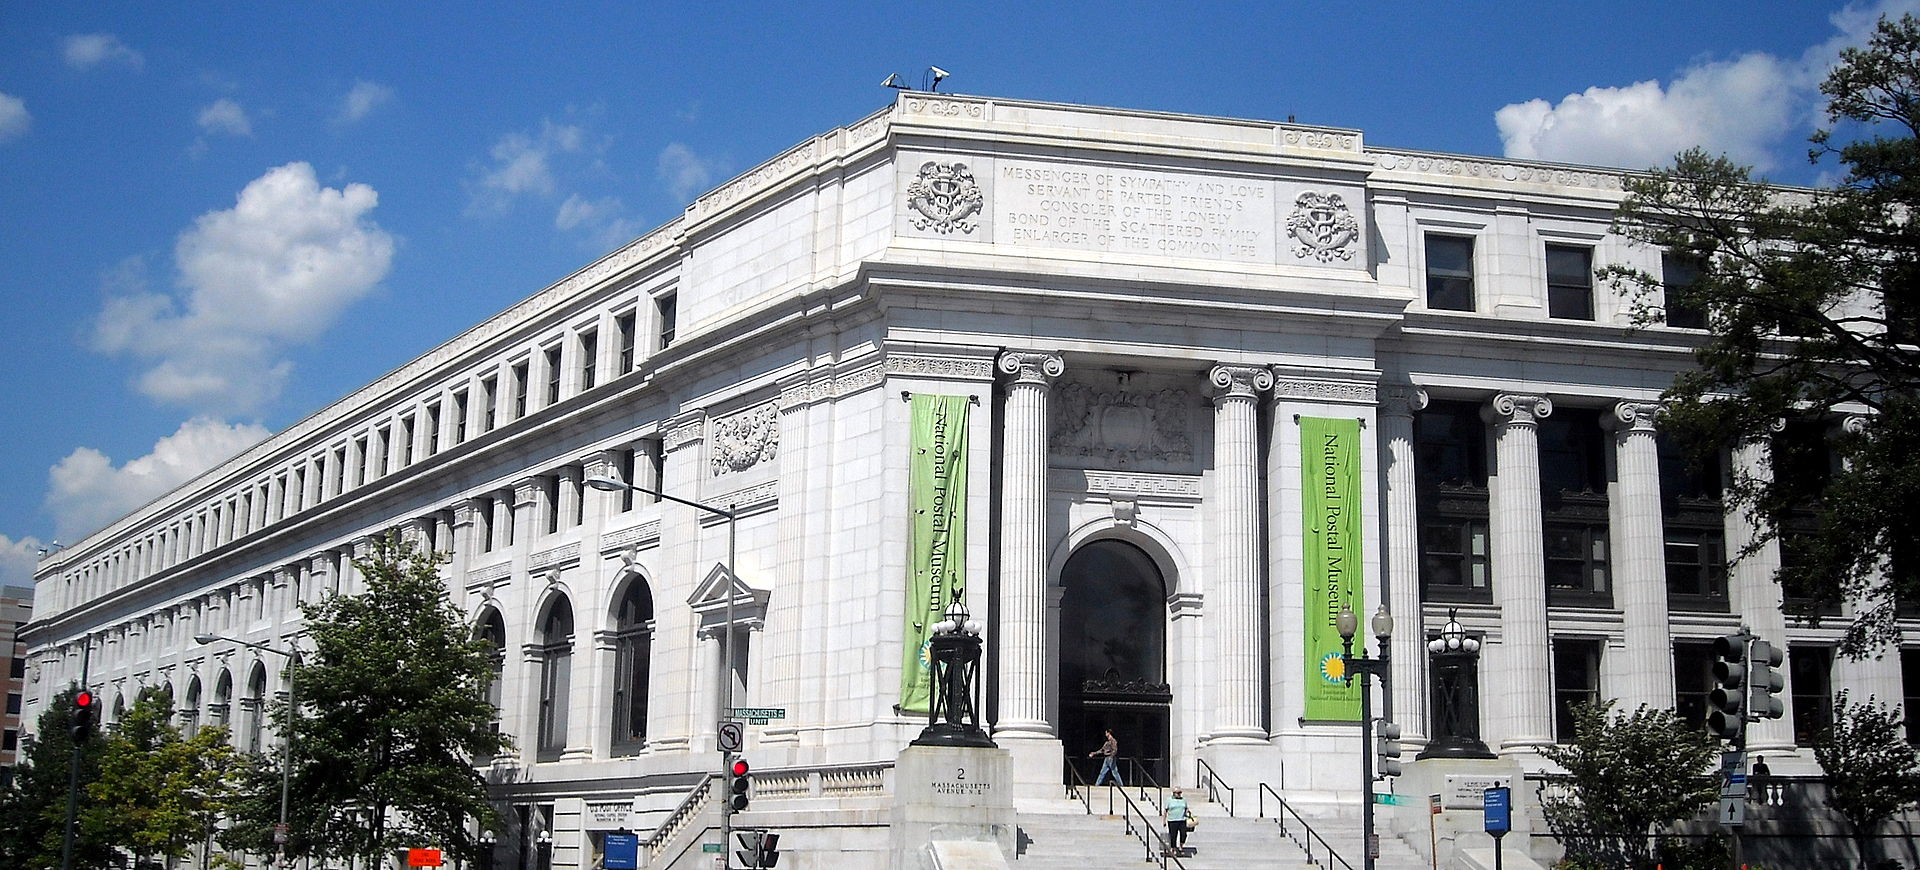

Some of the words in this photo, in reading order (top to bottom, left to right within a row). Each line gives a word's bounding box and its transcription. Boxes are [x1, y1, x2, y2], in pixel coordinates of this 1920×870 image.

[1003, 167, 1090, 185] MESSENGER
[1096, 174, 1113, 186] OF
[1120, 176, 1190, 193] SYMPATHY
[1197, 183, 1224, 195] AND
[1230, 185, 1264, 198] LOVE
[1027, 184, 1090, 199] SERVANT
[1096, 189, 1113, 201] OF
[1120, 191, 1172, 206] PARTED
[1181, 196, 1243, 211] FRIENDS
[1009, 213, 1049, 226] BOND
[1058, 216, 1077, 228] OF
[1083, 218, 1110, 231] THE
[1120, 221, 1203, 238] SCATTERED
[1212, 228, 1260, 242] FAMILY
[1040, 200, 1116, 216] CONSOLER
[1123, 206, 1140, 218] OF
[1146, 208, 1172, 221] THE
[1181, 211, 1231, 225] LONELY
[1014, 228, 1089, 244] ENLARGER
[1098, 234, 1115, 246] OF
[1123, 236, 1149, 249] THE
[1157, 239, 1220, 254] COMMON
[1228, 244, 1256, 257] LIFE
[935, 413, 948, 479] National
[1324, 434, 1341, 499] National
[933, 486, 947, 532] Postal
[1326, 506, 1343, 550] Postal
[930, 540, 946, 612] Museum
[1328, 556, 1343, 627] Museum
[735, 709, 777, 719] MASSACHUSETTS
[957, 768, 965, 780] 2
